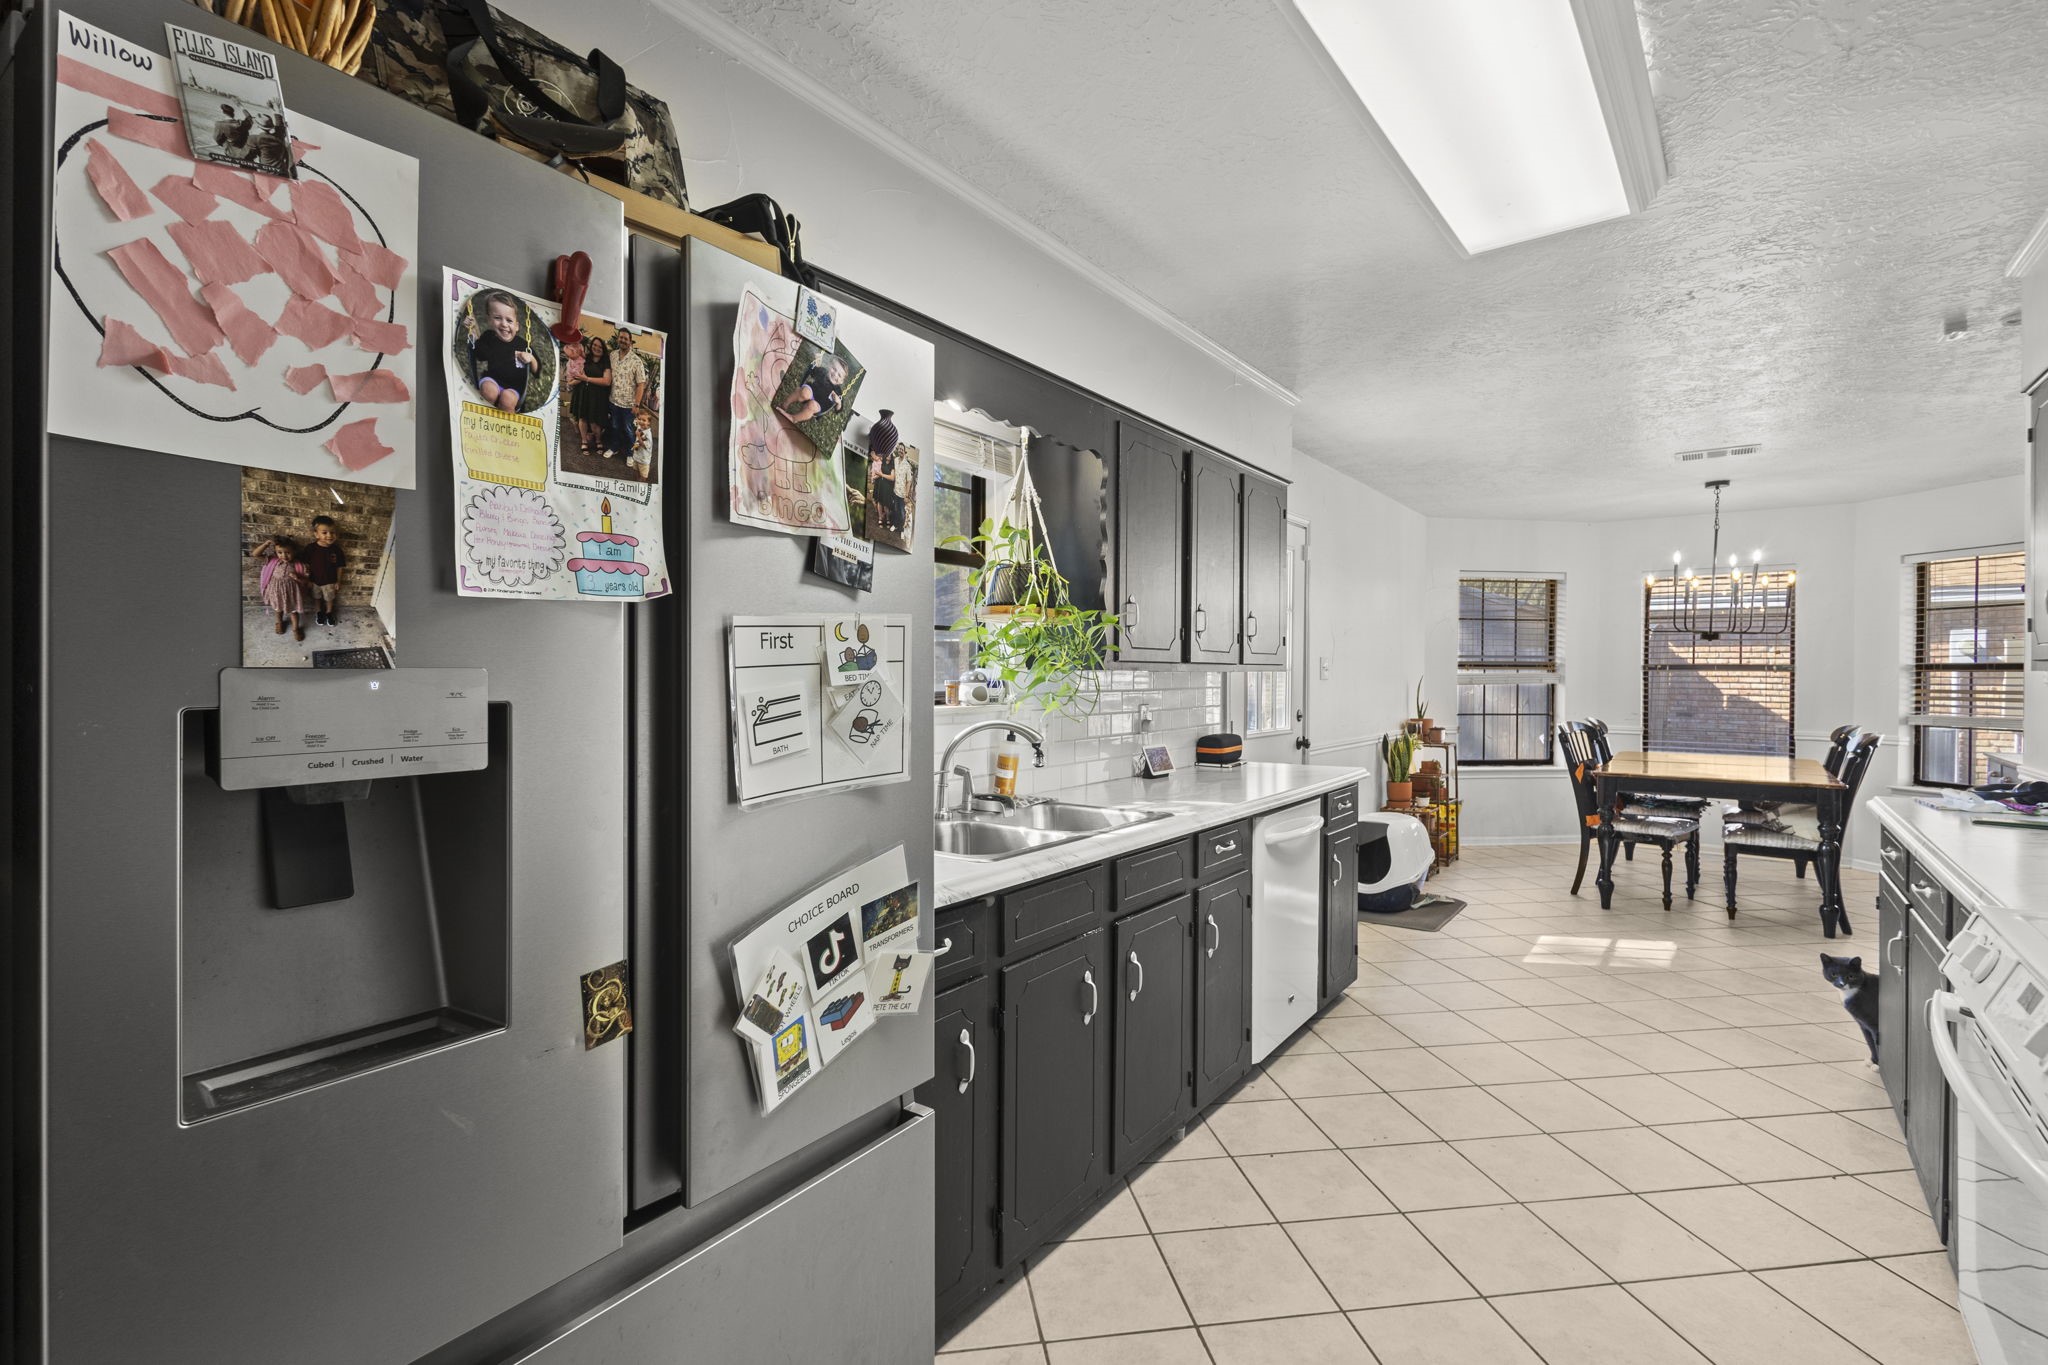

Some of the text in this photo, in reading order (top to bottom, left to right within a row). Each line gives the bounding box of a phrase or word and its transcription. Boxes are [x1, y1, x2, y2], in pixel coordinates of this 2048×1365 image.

[68, 20, 153, 71] Willow
[172, 28, 274, 79] ELLIS ISLAND
[190, 54, 263, 78] NATIONAL MONUMENT
[211, 153, 232, 162] NEW
[235, 159, 259, 168] YORK
[463, 416, 542, 441] my favorite food
[595, 479, 646, 496] my family
[757, 490, 827, 523] BINGO
[605, 547, 622, 556] am
[840, 536, 852, 547] THE
[853, 541, 870, 554] DATE
[485, 555, 545, 573] my favorite thing
[604, 582, 626, 593] years
[628, 581, 641, 592] old.
[760, 632, 794, 650] First
[844, 673, 872, 682] BED TIM
[843, 690, 856, 702] EAT
[870, 718, 894, 748] NAP TIME
[773, 744, 789, 755] BATH
[307, 755, 424, 769] Cubed Crushed Water
[788, 883, 860, 933] CHOICE BOARD
[869, 924, 914, 951] TRANSFORMERS
[828, 968, 850, 986] TIKTOK
[784, 985, 803, 1018] WHEELS
[873, 1002, 912, 1011] PETE THE CAT
[841, 1029, 857, 1046] Legos
[778, 1067, 812, 1100] SPONGEBOB
